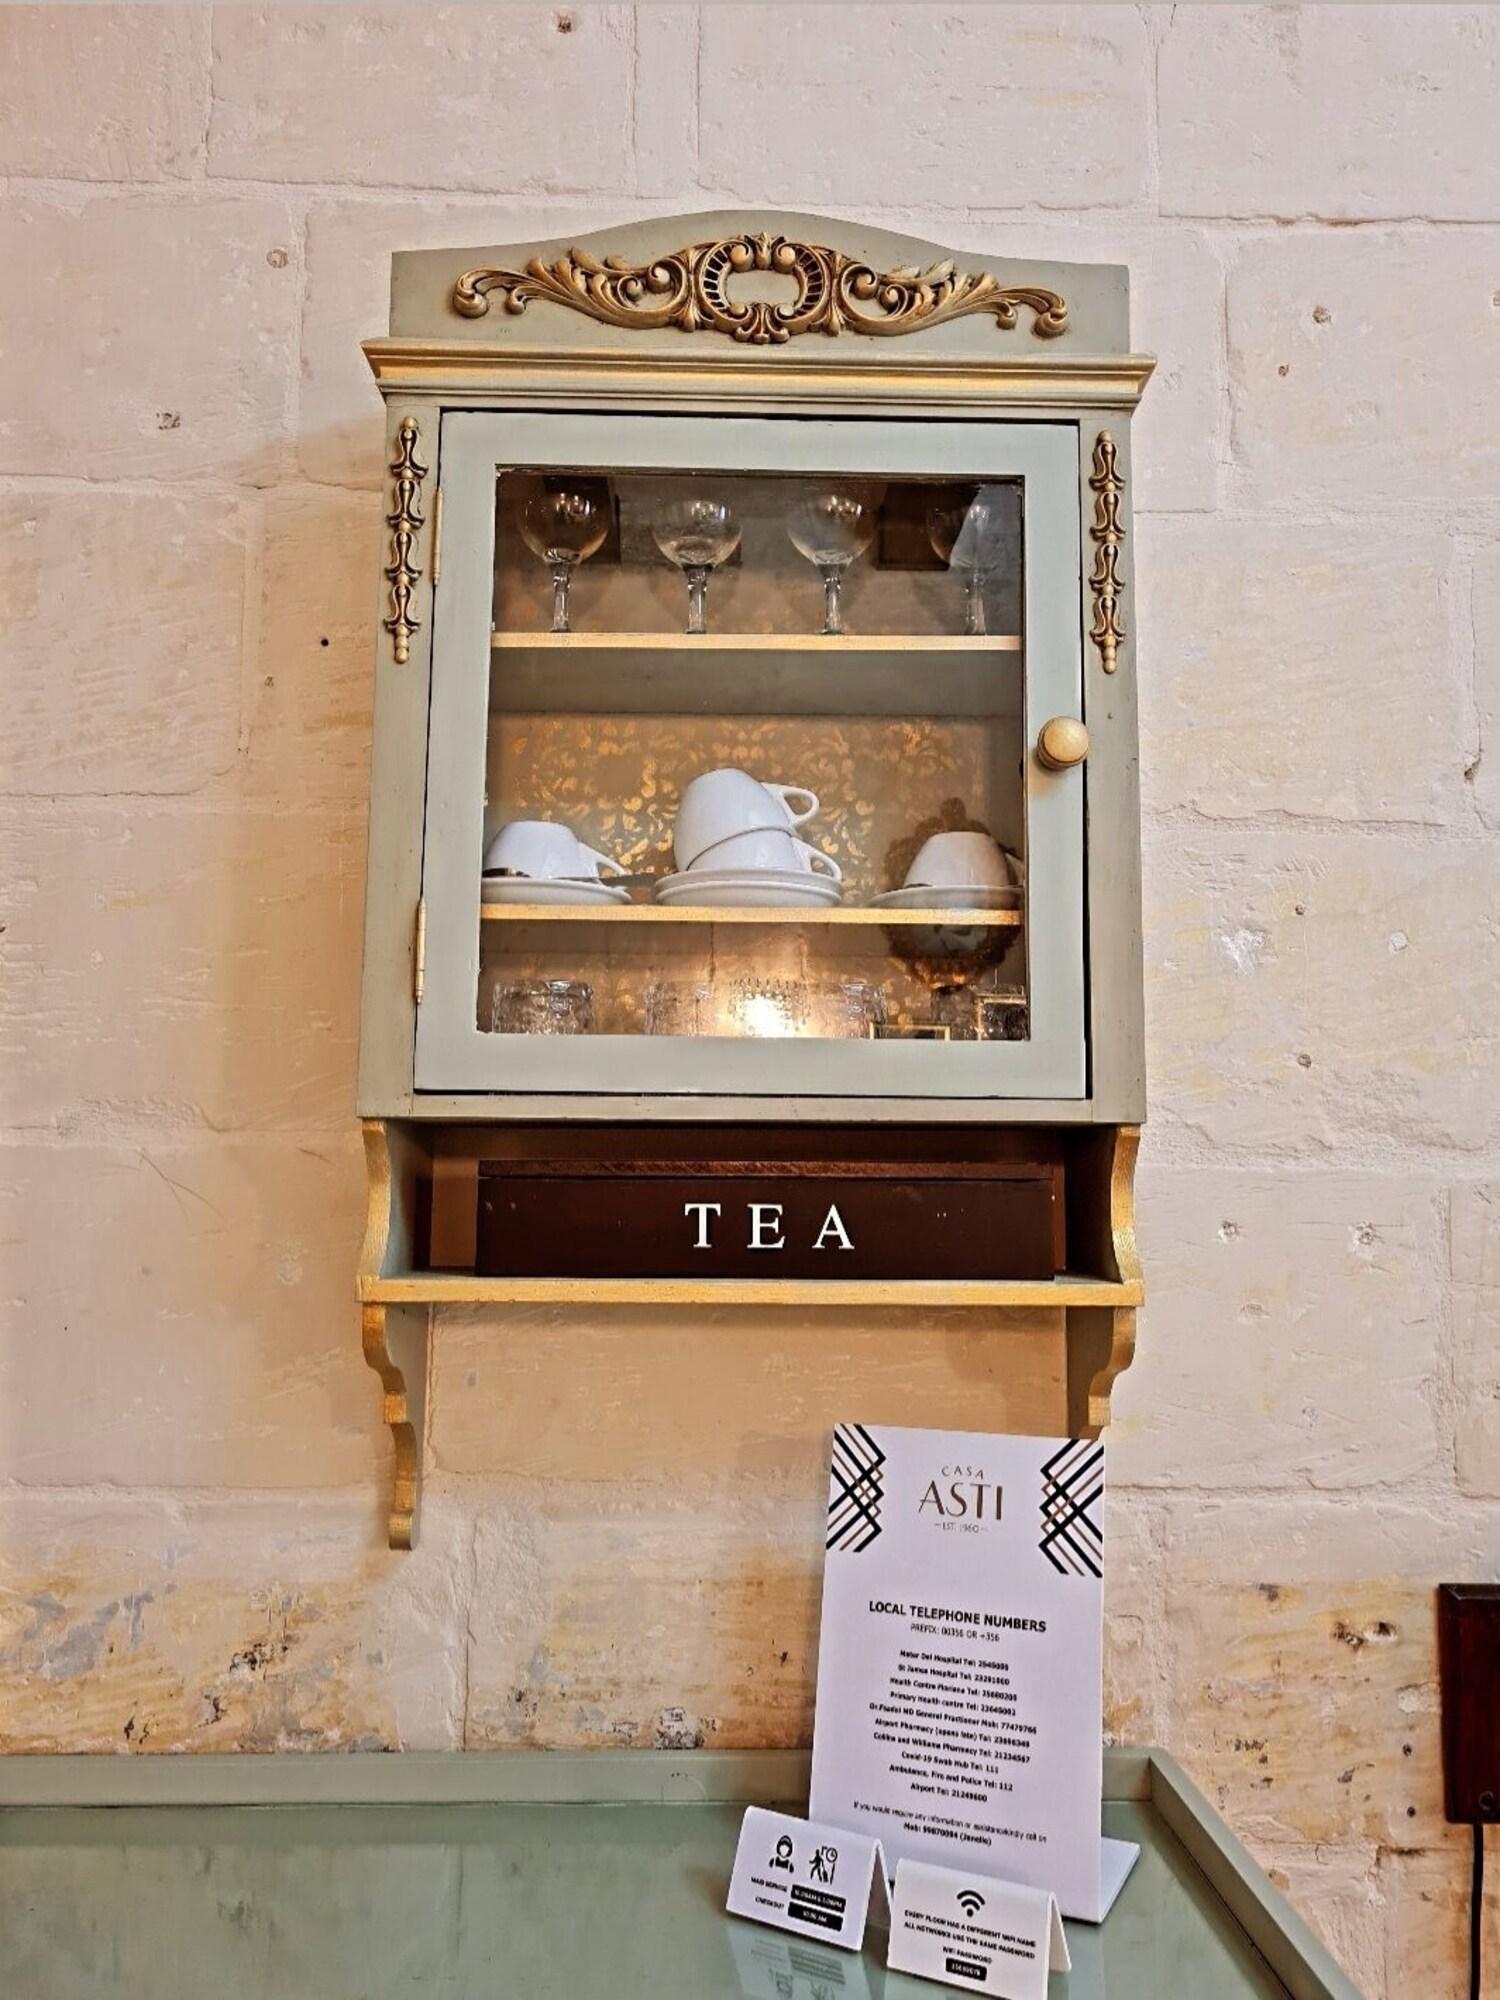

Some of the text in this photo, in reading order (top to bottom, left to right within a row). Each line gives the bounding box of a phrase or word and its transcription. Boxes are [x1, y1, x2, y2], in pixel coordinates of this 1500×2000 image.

[684, 1203, 856, 1250] TEA
[941, 1465, 984, 1480] CASA
[918, 1480, 1003, 1521] ASTI
[869, 1600, 1047, 1633] LOCAL TELEPHONE NUMBERS
[910, 1623, 939, 1634] PREFIX:
[941, 1627, 964, 1637] 00356
[980, 1631, 1000, 1641] +356
[934, 1654, 962, 1667] Hospital
[930, 1668, 958, 1681] Hospital
[890, 1676, 911, 1687] Health
[967, 1687, 980, 1697] Tel:
[966, 1701, 979, 1711] Tel:
[916, 1709, 942, 1720] General
[901, 1721, 933, 1735] Pharmacy
[943, 1742, 977, 1757] Pharmacy
[910, 1782, 935, 1795] Airport
[946, 1773, 959, 1783] and
[961, 1775, 982, 1786] Police
[984, 1779, 997, 1788] Tel:
[999, 1781, 1013, 1791] 112
[947, 1920, 960, 1929] HAS
[1017, 1937, 1036, 1947] NAME
